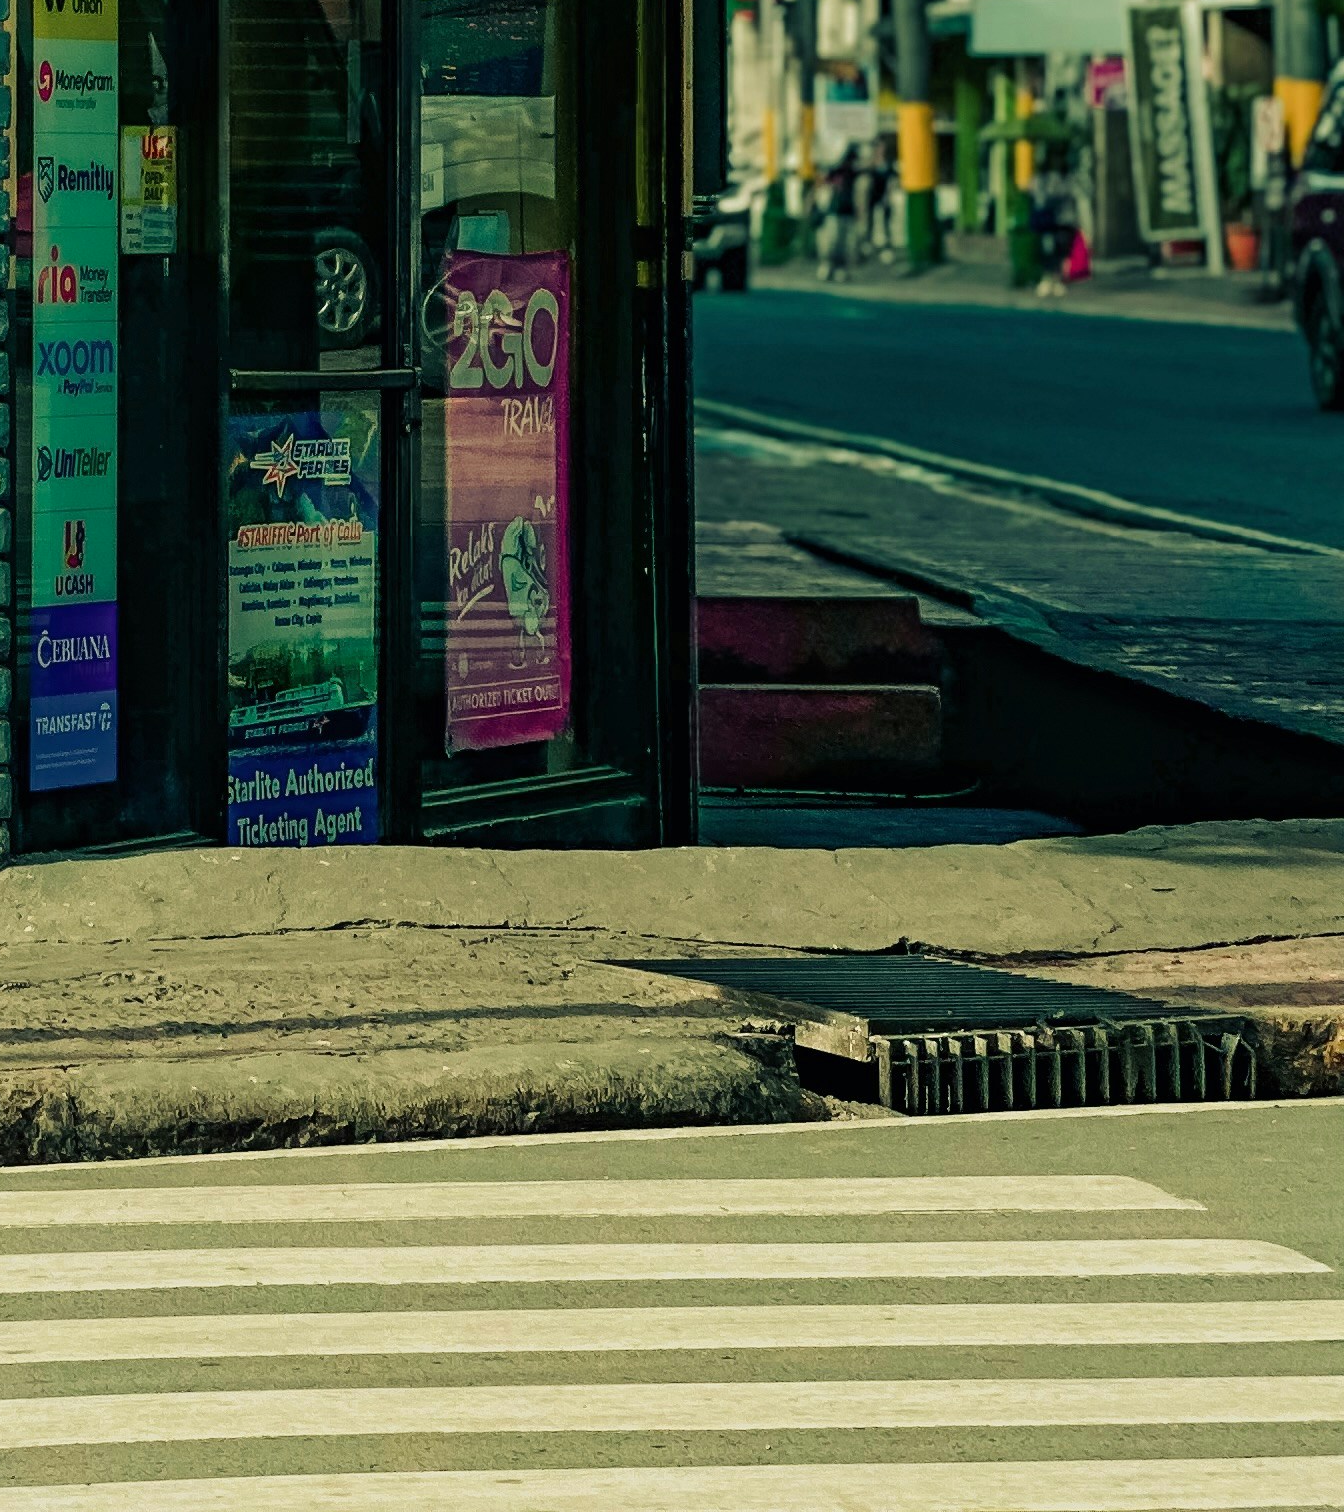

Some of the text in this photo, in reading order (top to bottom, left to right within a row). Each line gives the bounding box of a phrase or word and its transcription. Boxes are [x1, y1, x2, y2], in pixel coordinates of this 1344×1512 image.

[55, 70, 114, 96] MoneyGram
[57, 161, 113, 200] Remitly
[38, 245, 76, 304] ria
[37, 340, 113, 376] xoom
[450, 288, 559, 389] 2GO
[36, 712, 97, 736] TRANSFAST
[228, 758, 374, 805] Starlite Authorized
[237, 806, 362, 846] Ticketing Agent
